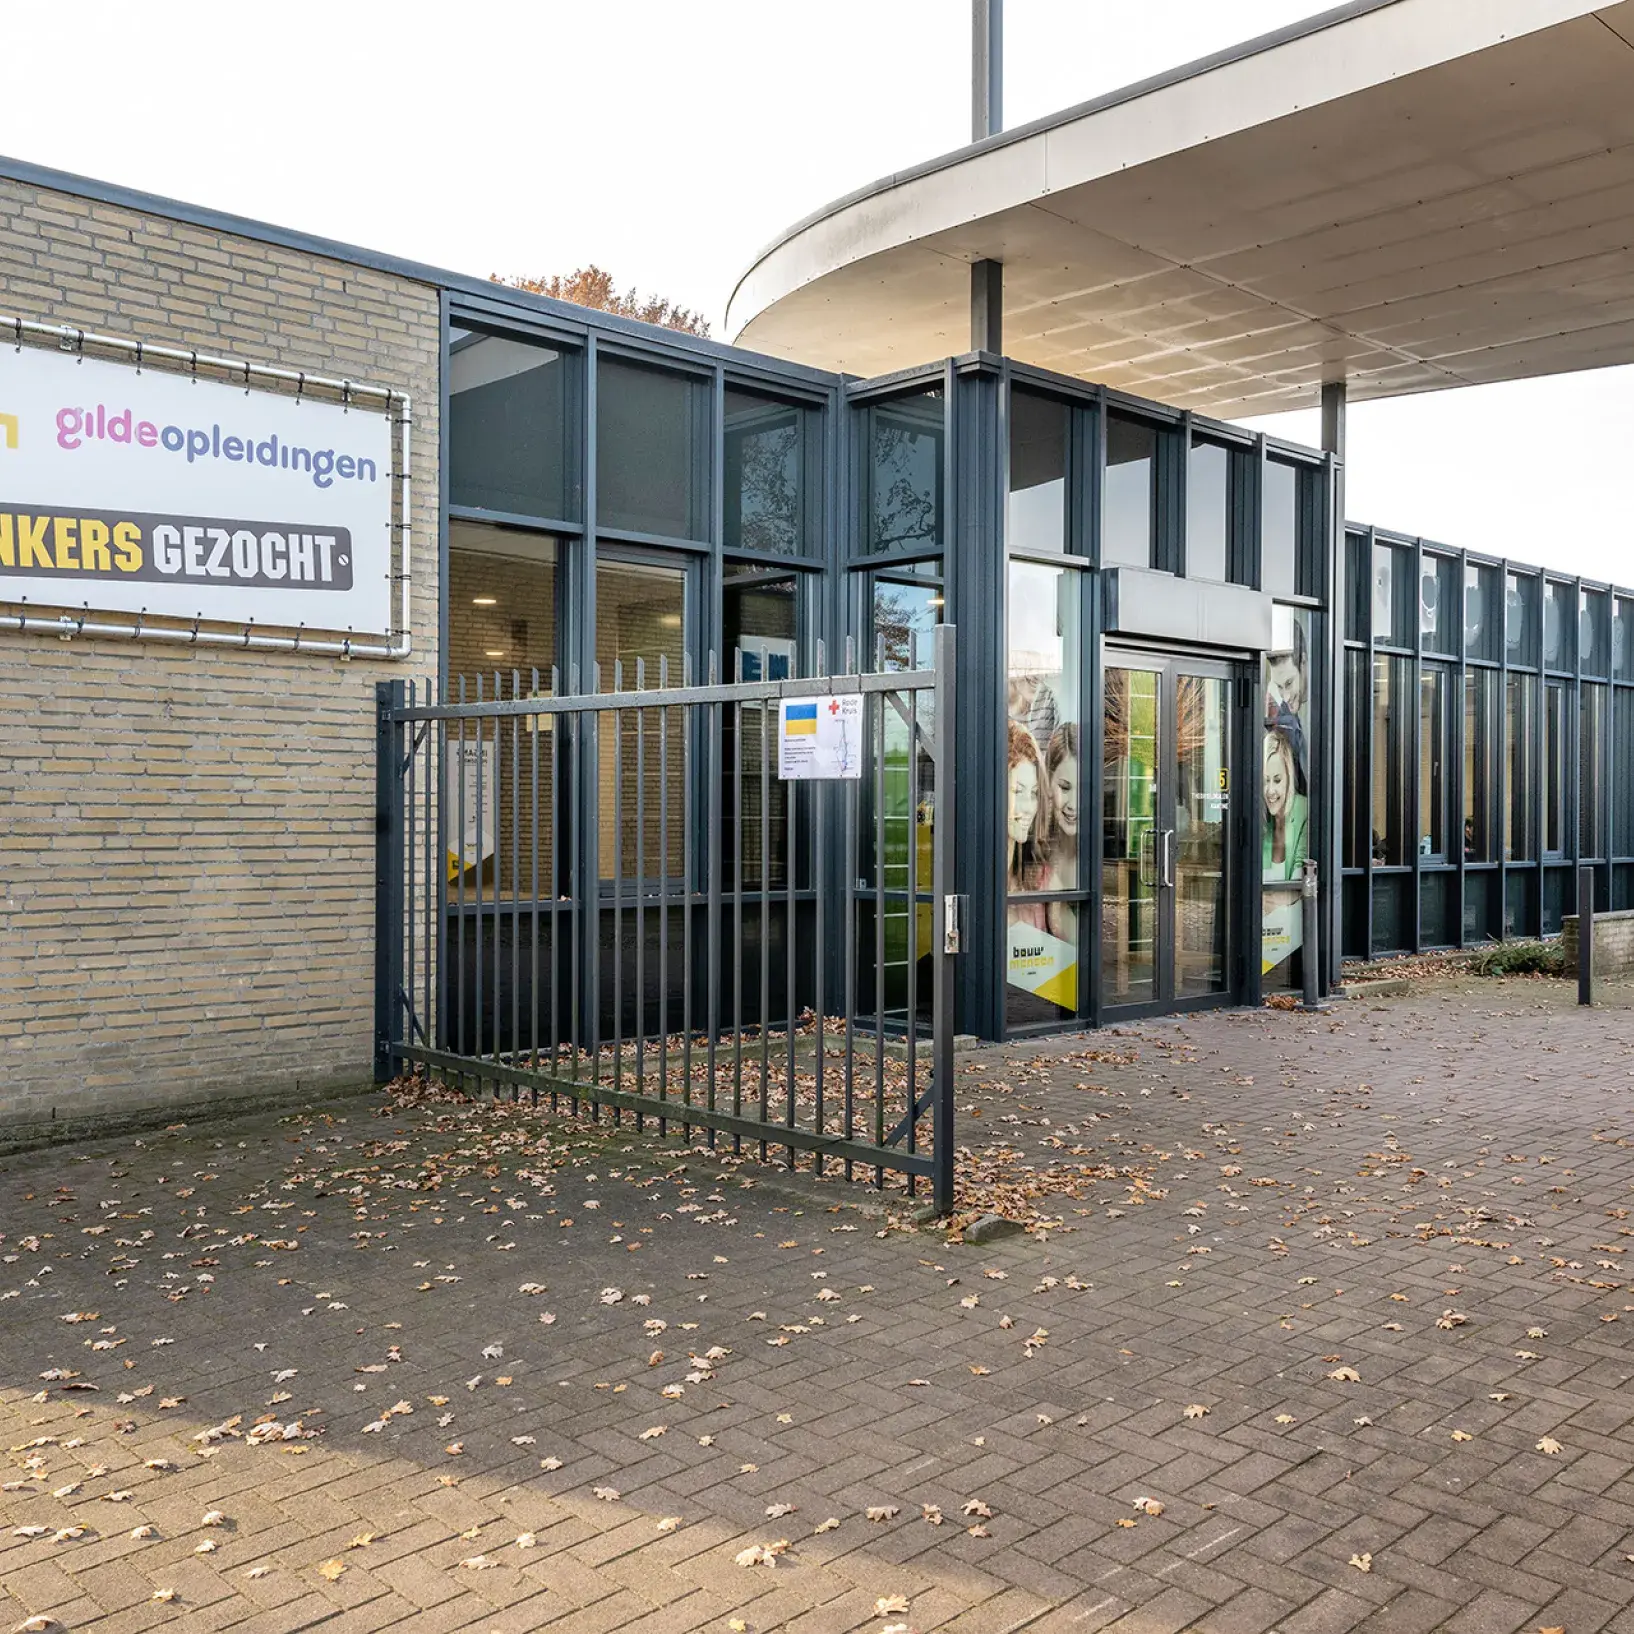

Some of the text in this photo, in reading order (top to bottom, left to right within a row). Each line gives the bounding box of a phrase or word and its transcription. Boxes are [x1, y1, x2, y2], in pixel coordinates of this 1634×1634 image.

[56, 404, 377, 488] gildeopleidingen
[152, 524, 337, 582] GEZOCHT
[1013, 946, 1044, 958] bouw
